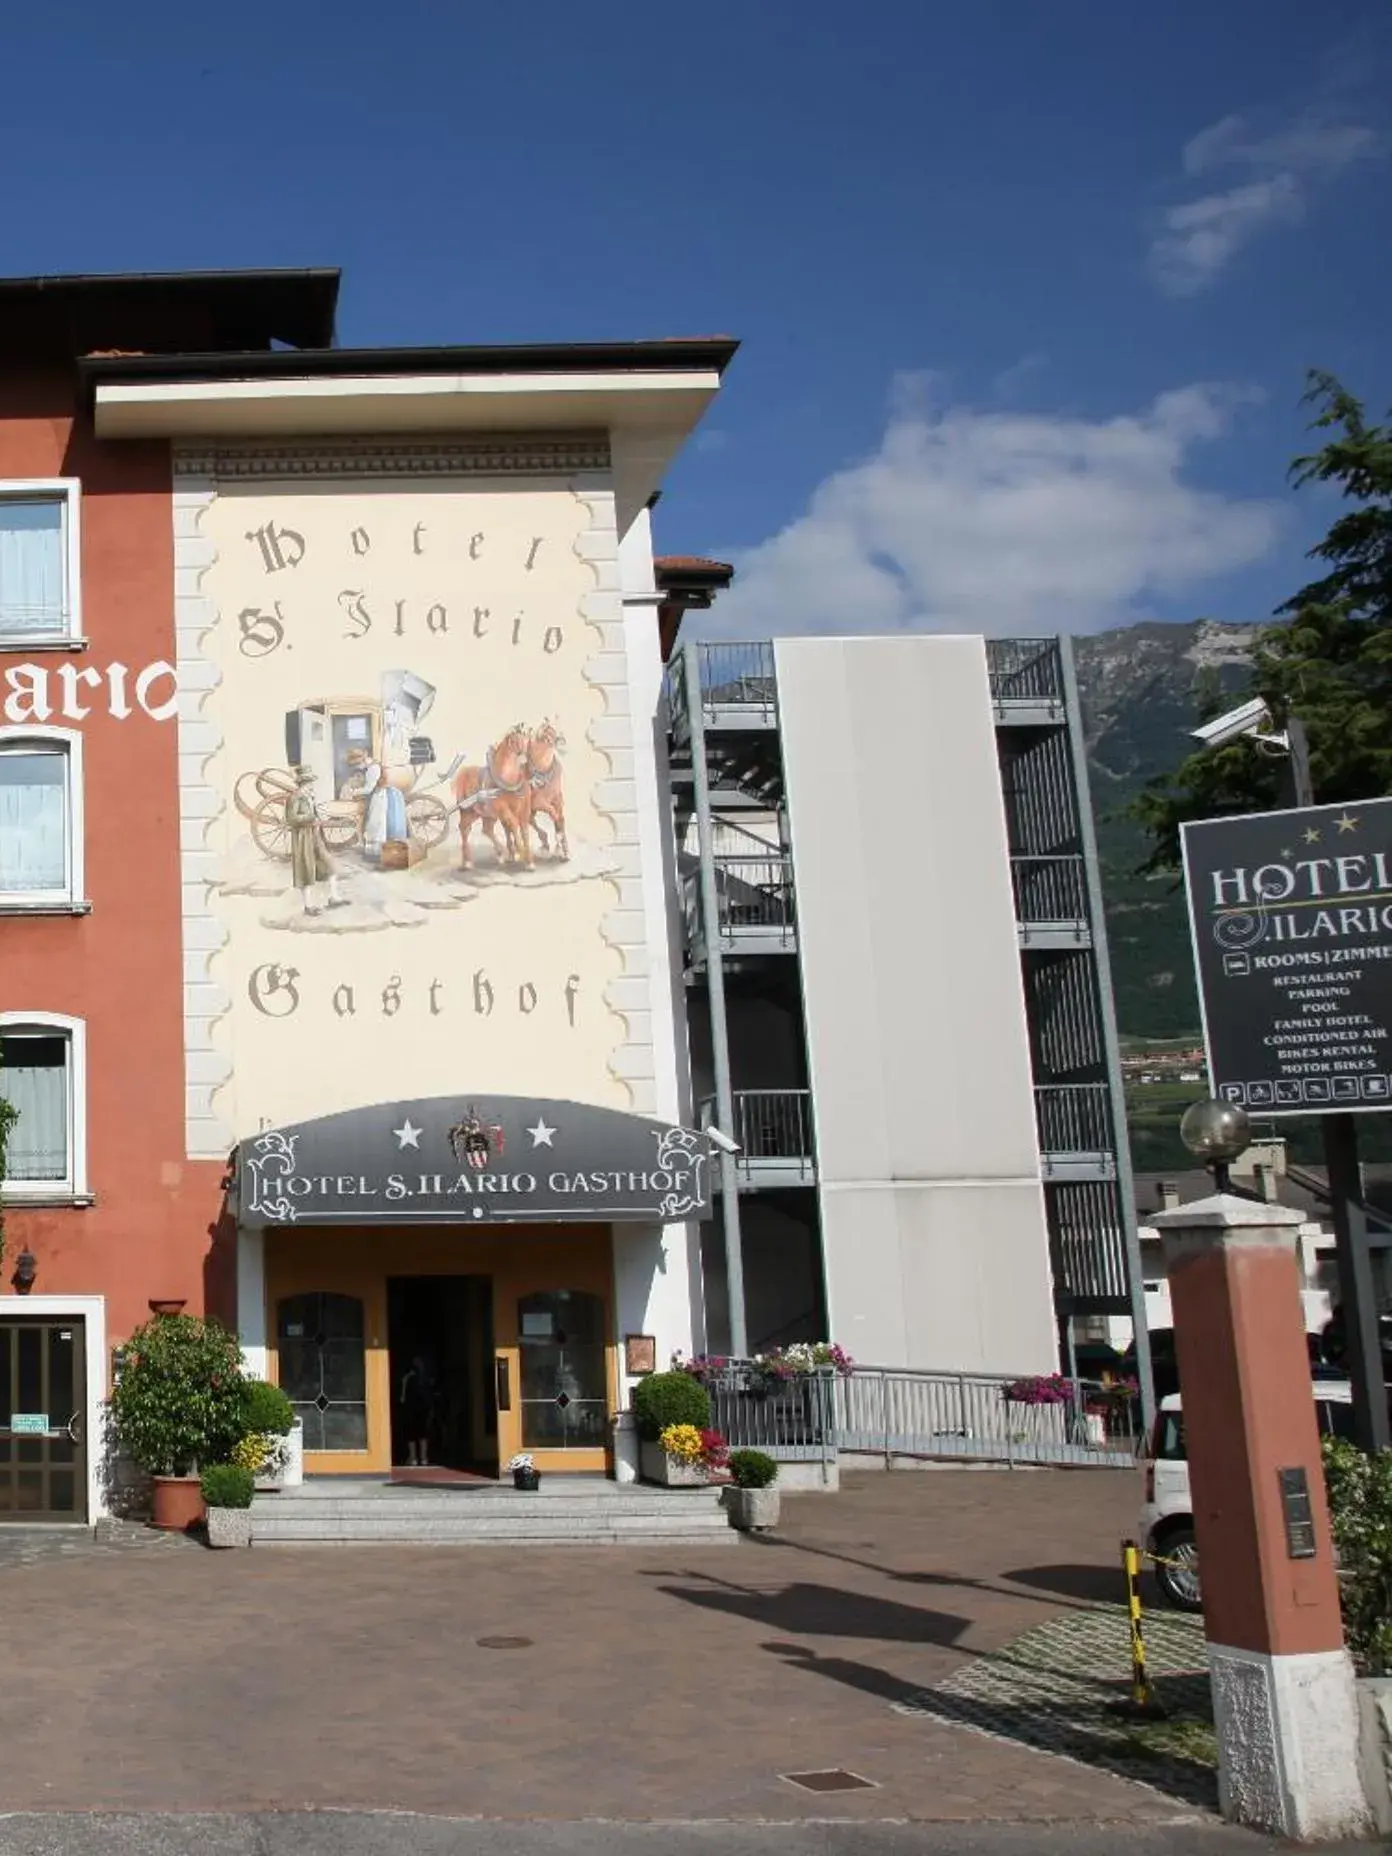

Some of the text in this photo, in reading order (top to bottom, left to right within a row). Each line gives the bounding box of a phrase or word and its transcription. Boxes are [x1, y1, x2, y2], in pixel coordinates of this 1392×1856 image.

[244, 519, 545, 575] Hotel
[337, 589, 564, 656] Ilario
[1273, 969, 1363, 987] RESTAURANT
[247, 961, 581, 1027] Gasthof
[1287, 986, 1351, 1000] PARKING
[1301, 1002, 1340, 1013] POOL
[1274, 1015, 1373, 1031] FAMILY HOTEL
[1263, 1028, 1388, 1046] CONDITIONED AIR
[1277, 1044, 1377, 1060] BIKES RENTAL
[1281, 1058, 1377, 1074] MOTOR BIKES
[262, 1175, 379, 1197] HOTEL
[548, 1170, 690, 1193] GASTHOF
